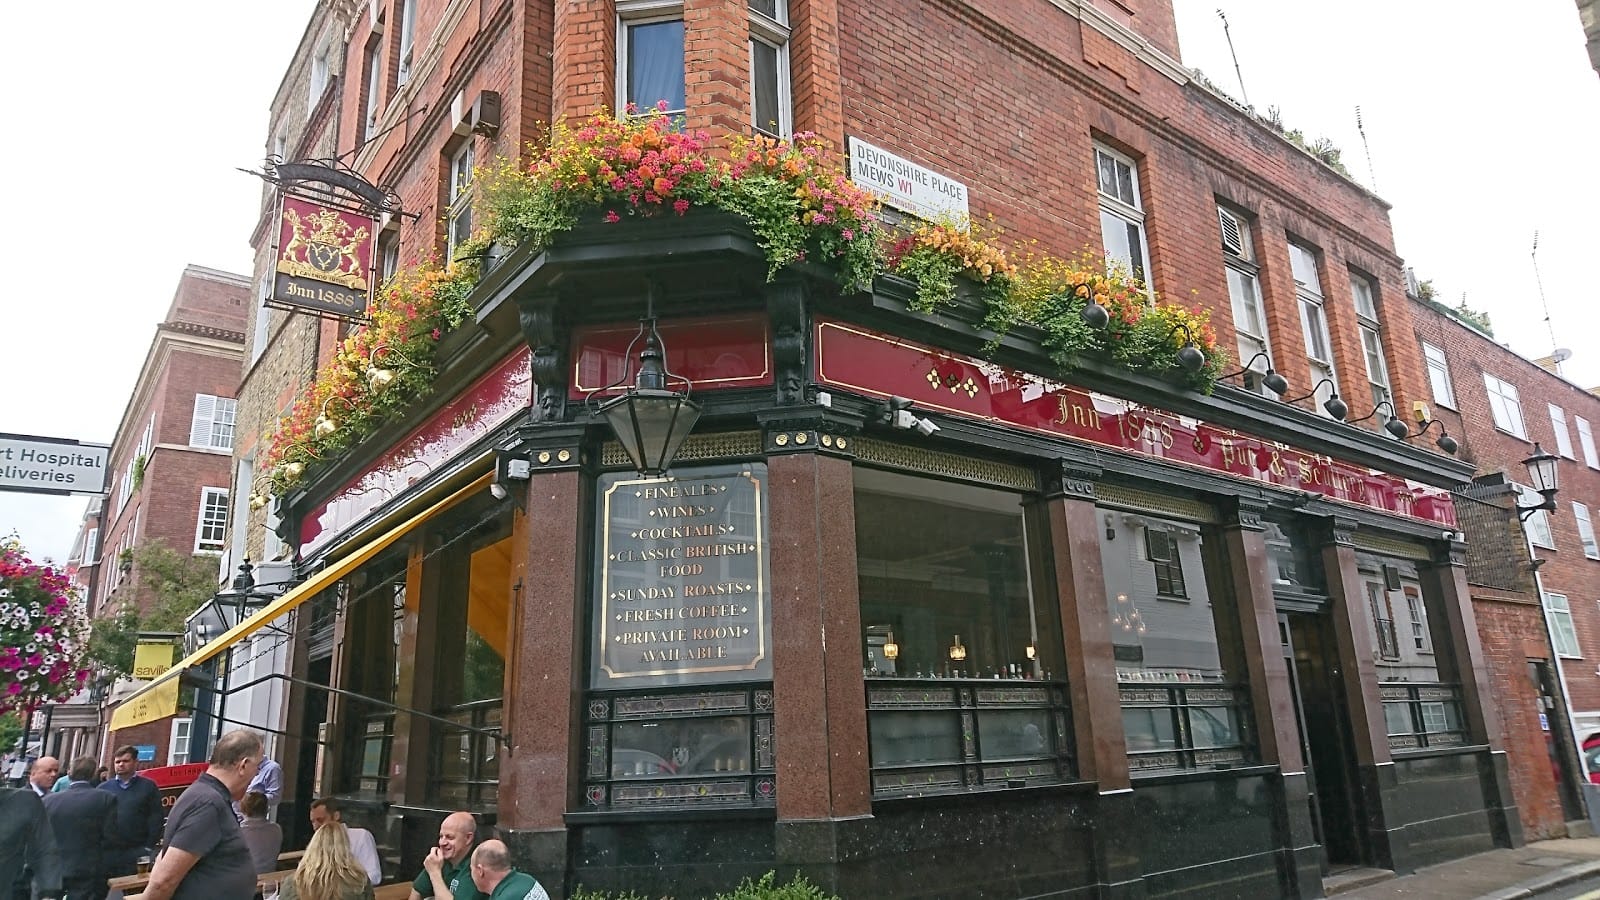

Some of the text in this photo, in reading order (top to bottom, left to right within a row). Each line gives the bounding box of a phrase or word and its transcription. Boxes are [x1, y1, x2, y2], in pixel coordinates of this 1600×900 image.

[857, 144, 962, 201] DEVONSHIRE PLACE
[858, 161, 913, 196] MEWS W1
[285, 282, 354, 307] Inn 1888
[1055, 393, 1101, 431] Inn
[1115, 409, 1173, 450] 1888
[1270, 450, 1286, 478] &
[20, 448, 101, 468] Hospital
[645, 484, 718, 499] FINE ALES
[657, 505, 706, 518] WINES
[639, 523, 727, 540] COCKTAILS
[617, 543, 748, 562] CLASSIC BRITISH
[660, 563, 703, 578] FOOD
[617, 582, 744, 601] SUNDAY ROASTS
[624, 604, 739, 622] FRESH COFFEE
[623, 626, 741, 645] PRIVATE ROOM
[640, 646, 727, 663] AVAILABLE
